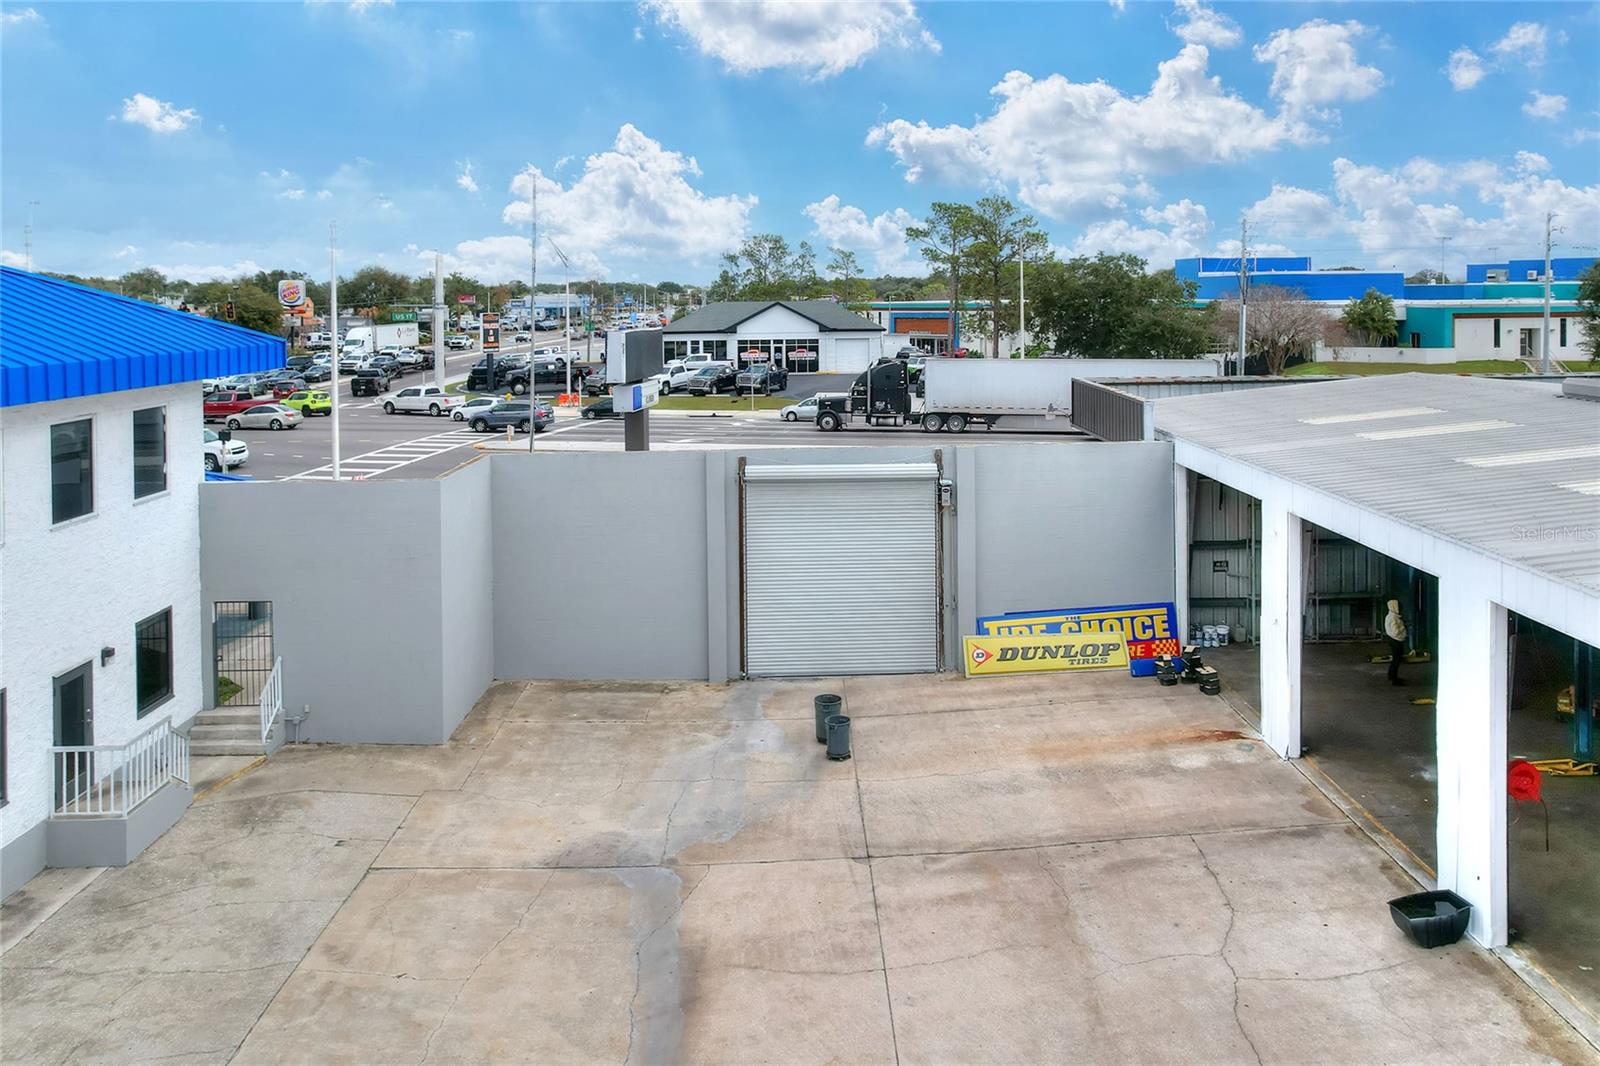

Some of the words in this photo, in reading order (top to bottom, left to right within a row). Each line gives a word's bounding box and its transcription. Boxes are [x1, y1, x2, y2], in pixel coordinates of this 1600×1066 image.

[282, 288, 300, 299] KING
[1060, 615, 1171, 641] CHOICE
[996, 642, 1121, 662] DUNLOP
[1128, 644, 1146, 657] RE
[1068, 656, 1108, 666] TIRES
